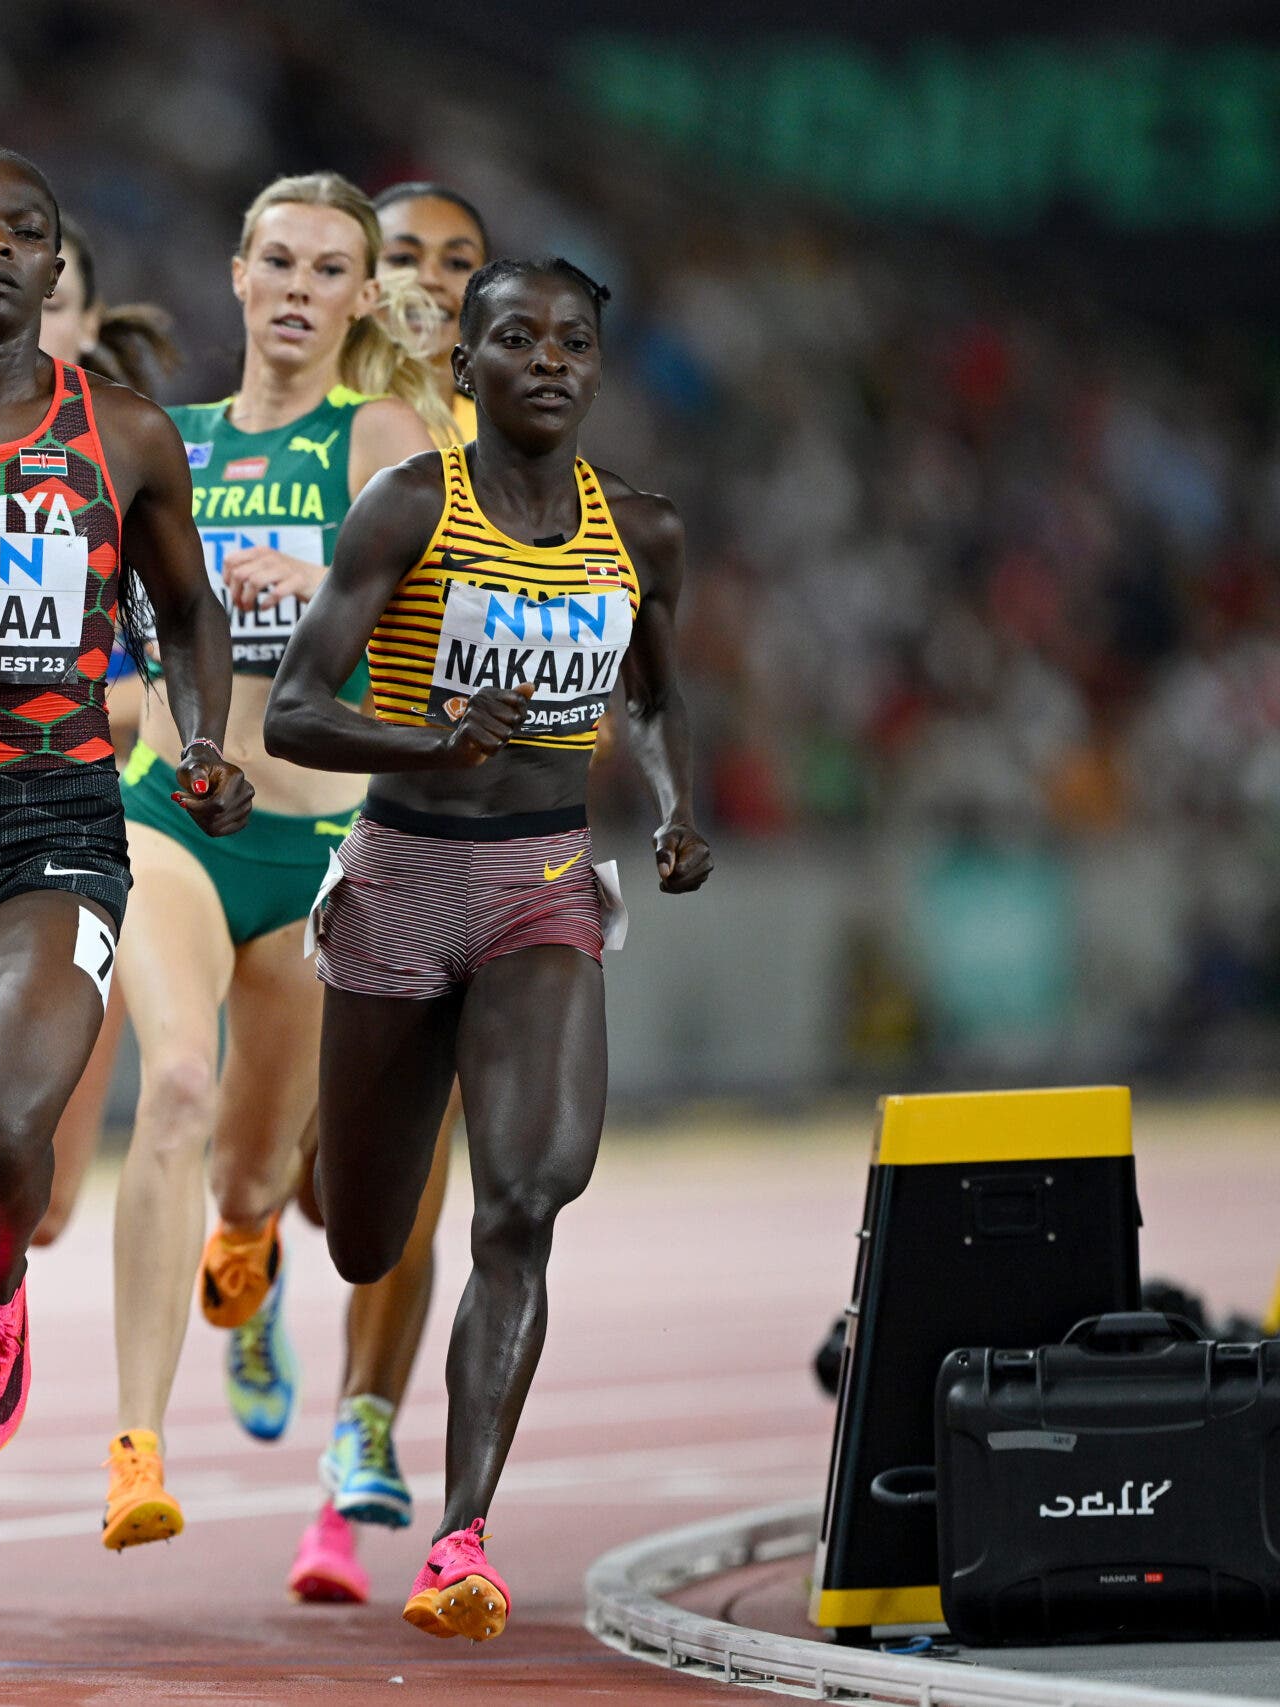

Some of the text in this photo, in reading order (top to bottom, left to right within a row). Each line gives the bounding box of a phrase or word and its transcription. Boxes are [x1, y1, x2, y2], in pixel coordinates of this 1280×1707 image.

[192, 482, 324, 520] STRALIA
[484, 593, 606, 643] NTN
[42, 657, 65, 673] 23
[444, 638, 618, 694] NAKAAYI
[523, 702, 605, 725] DAPEST 23
